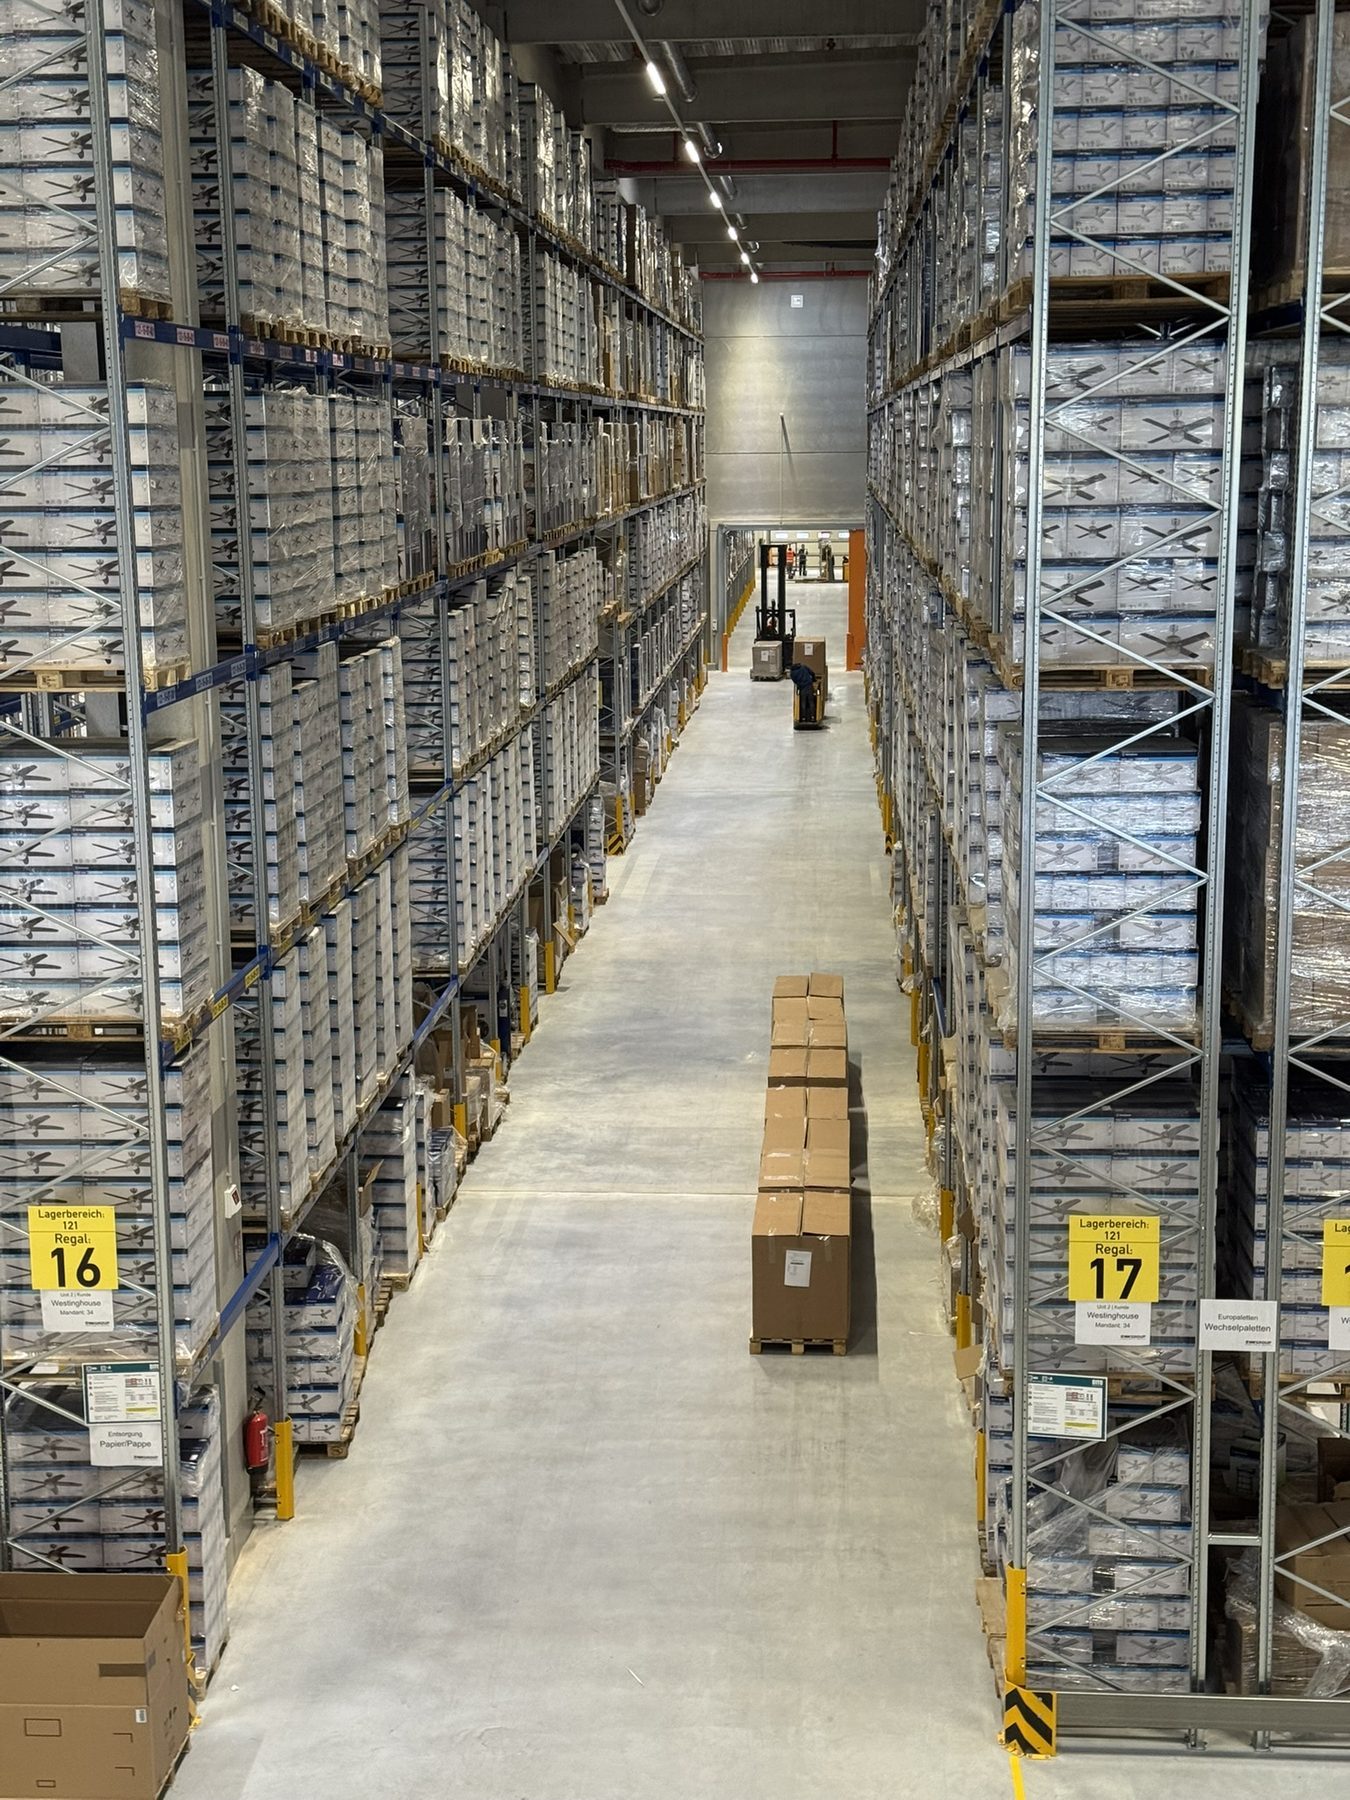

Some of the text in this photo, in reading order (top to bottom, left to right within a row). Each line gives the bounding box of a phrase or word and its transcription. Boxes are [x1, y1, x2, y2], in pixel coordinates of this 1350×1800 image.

[38, 1209, 105, 1220] Lagerbereich:
[63, 1221, 78, 1230] 121
[1080, 1219, 1149, 1230] Lagerbereich:
[55, 1233, 91, 1246] Regal:
[1105, 1231, 1120, 1240] 121
[1095, 1243, 1133, 1257] Regal:
[51, 1247, 101, 1288] 16
[1090, 1258, 1142, 1299] 17
[51, 1299, 101, 1307] Westinghouse
[1087, 1311, 1139, 1320] Westinghouse
[1218, 1313, 1259, 1321] Europaletten
[1204, 1322, 1271, 1332] Wechselpaletten
[100, 1440, 152, 1448] Papier/Pappe
